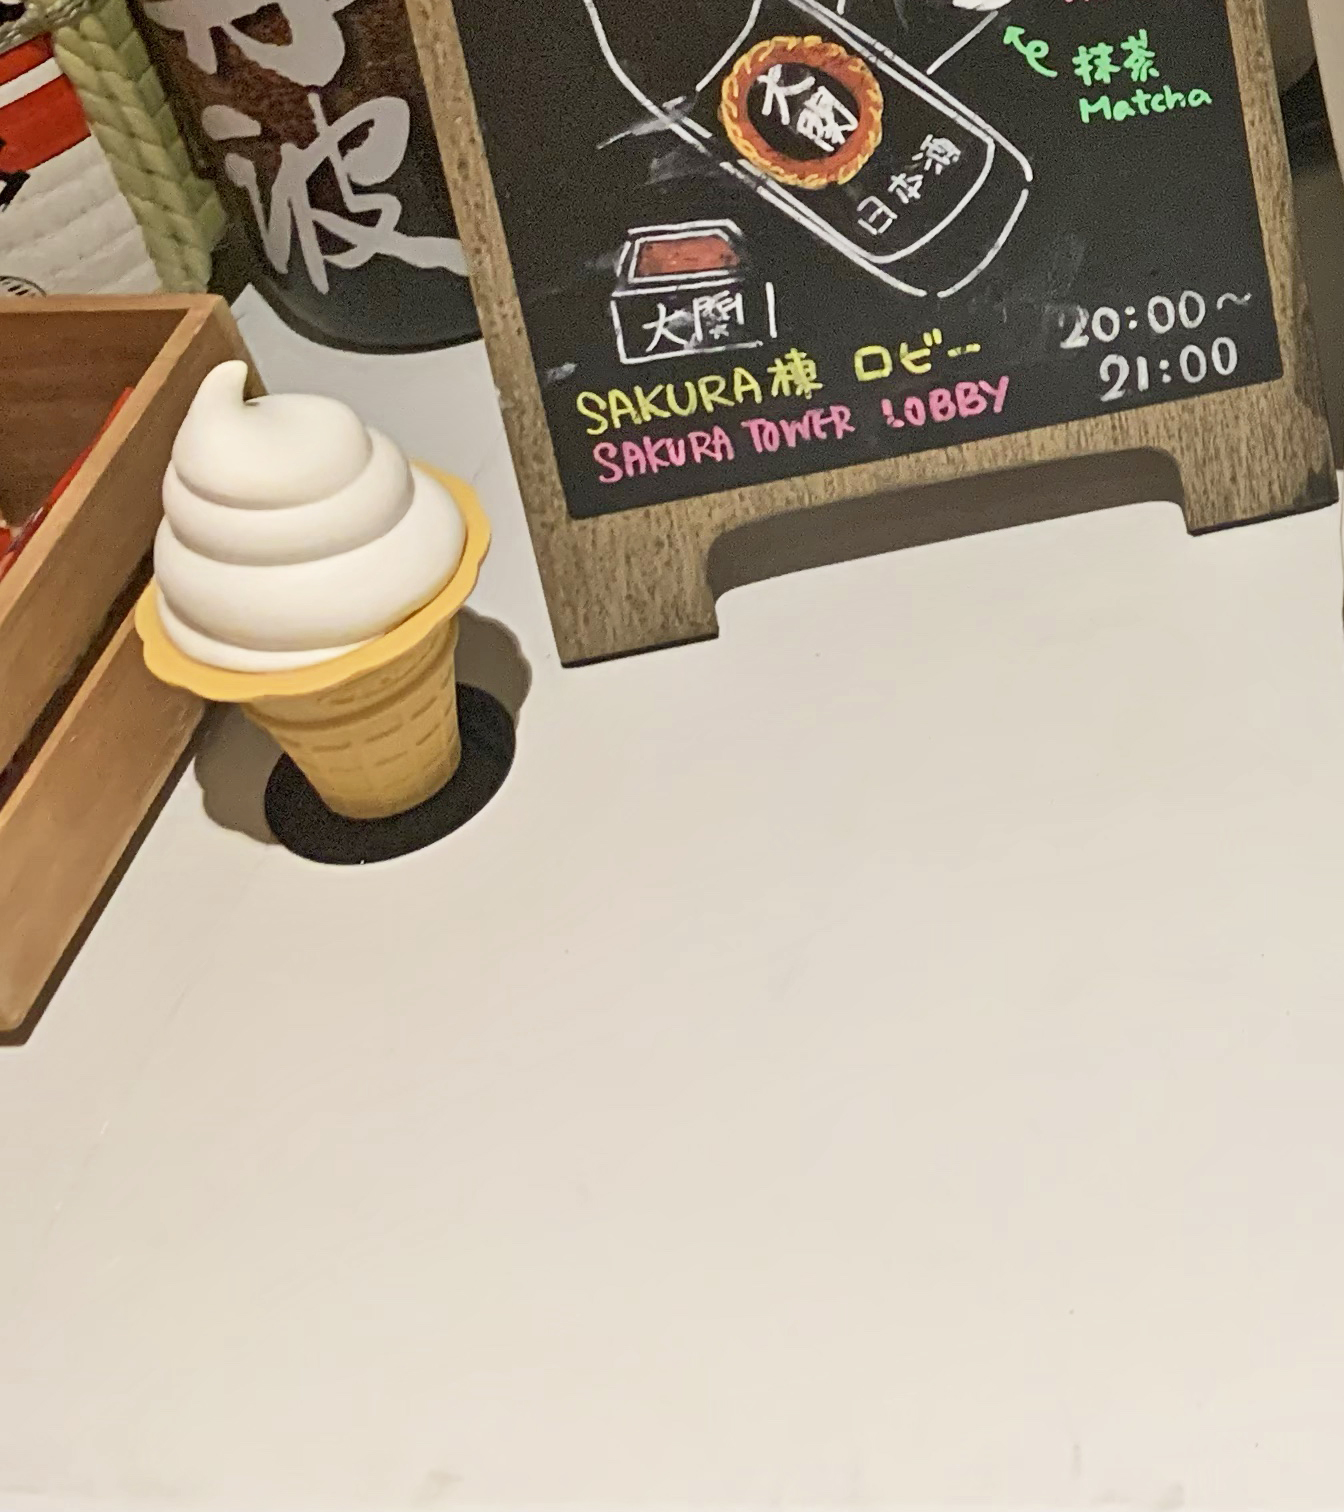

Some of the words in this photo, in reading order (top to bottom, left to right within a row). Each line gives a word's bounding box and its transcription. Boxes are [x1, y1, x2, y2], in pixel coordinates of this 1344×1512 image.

[1072, 29, 1160, 87] 抹茶
[1079, 85, 1212, 124] Matcha
[853, 328, 982, 382] ロビー
[1099, 336, 1239, 403] 21:00
[592, 417, 736, 485] SAKURA
[741, 403, 856, 455] TOWER
[882, 376, 1011, 431] LOBBY
